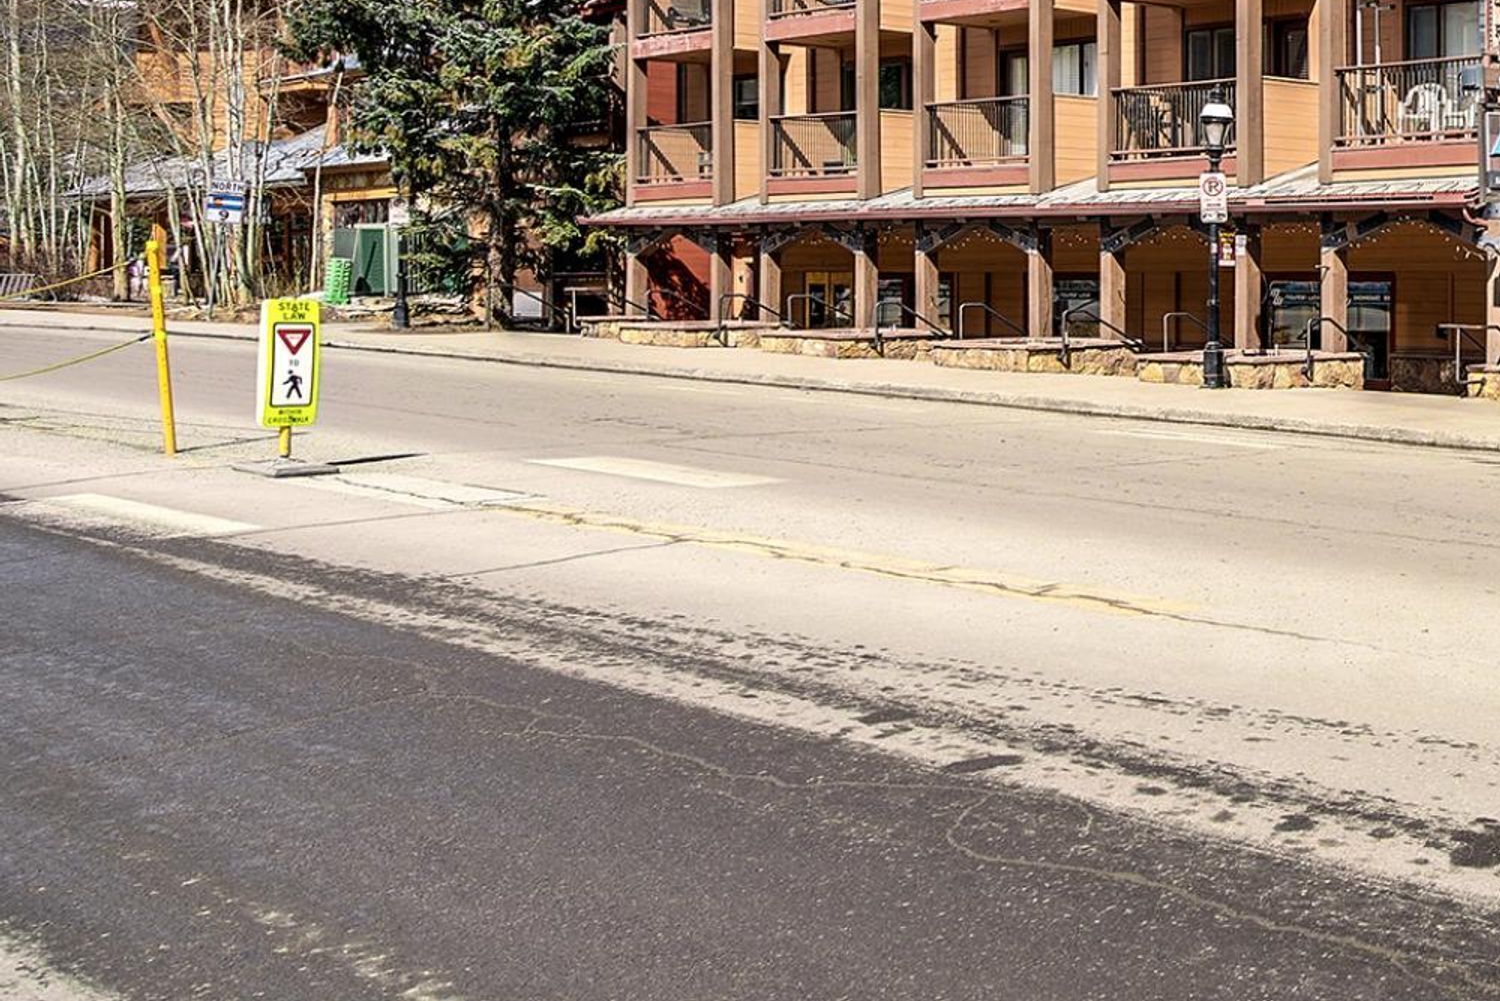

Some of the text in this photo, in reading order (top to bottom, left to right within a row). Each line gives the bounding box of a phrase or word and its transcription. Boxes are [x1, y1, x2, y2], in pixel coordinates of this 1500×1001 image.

[212, 181, 244, 192] NORTH
[219, 210, 229, 220] 9
[278, 302, 311, 312] STATE
[283, 312, 305, 320] LAW
